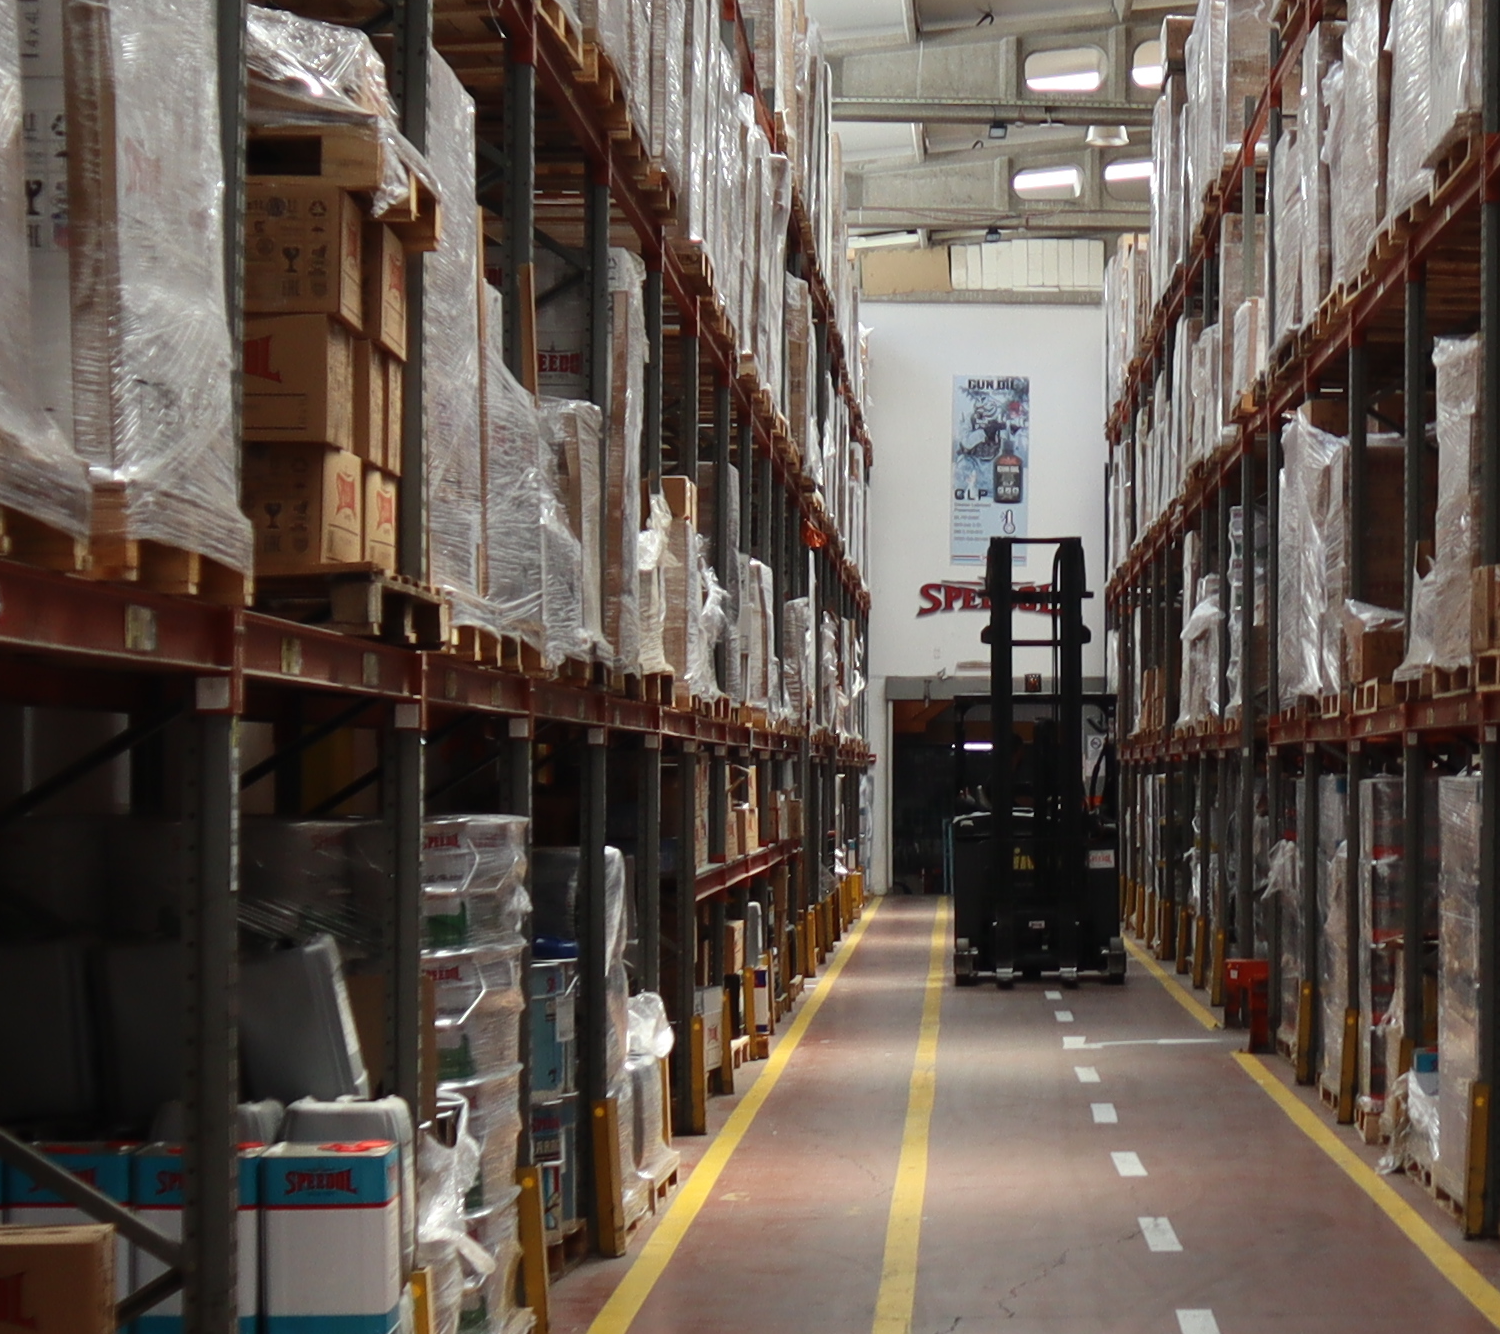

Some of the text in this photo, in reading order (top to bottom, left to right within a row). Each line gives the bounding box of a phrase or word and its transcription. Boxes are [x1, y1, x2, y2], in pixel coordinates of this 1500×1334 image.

[968, 378, 994, 391] GUN
[953, 487, 989, 501] CLP
[283, 1167, 358, 1196] SPEEDOL
